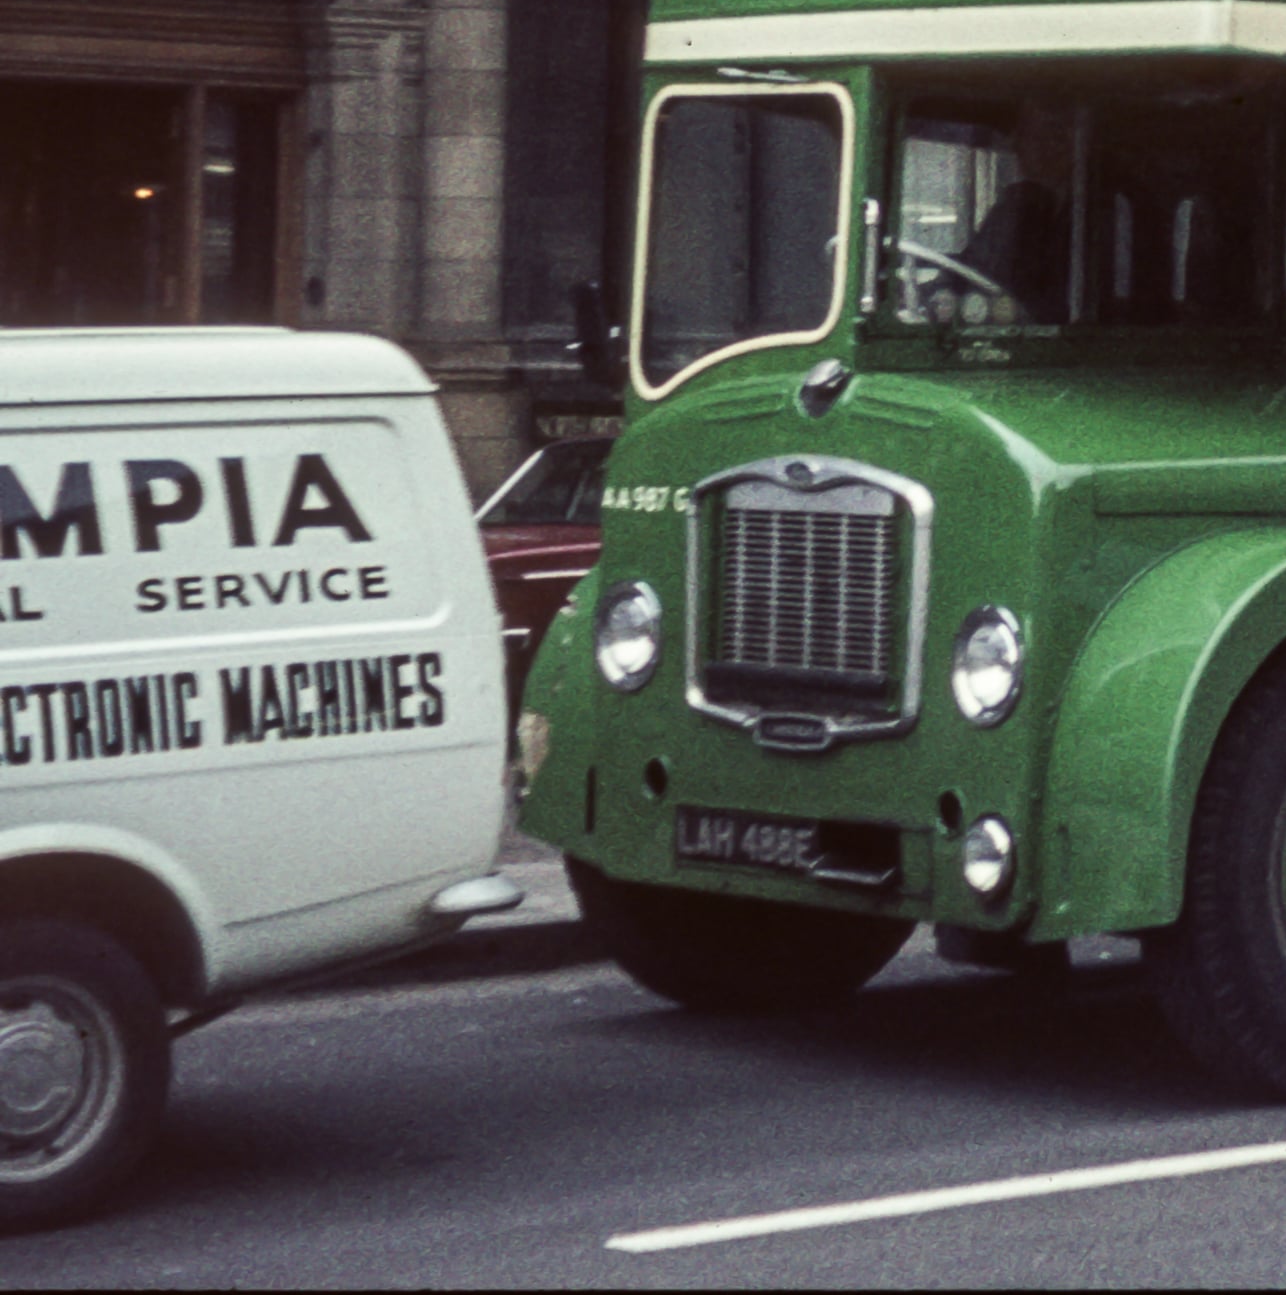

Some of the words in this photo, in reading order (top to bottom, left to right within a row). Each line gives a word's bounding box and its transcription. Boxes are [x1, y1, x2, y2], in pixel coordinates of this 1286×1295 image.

[0, 586, 43, 622] L
[136, 564, 391, 613] SERVICE
[0, 670, 203, 767] CTRONIC
[218, 650, 447, 746] MACHINES
